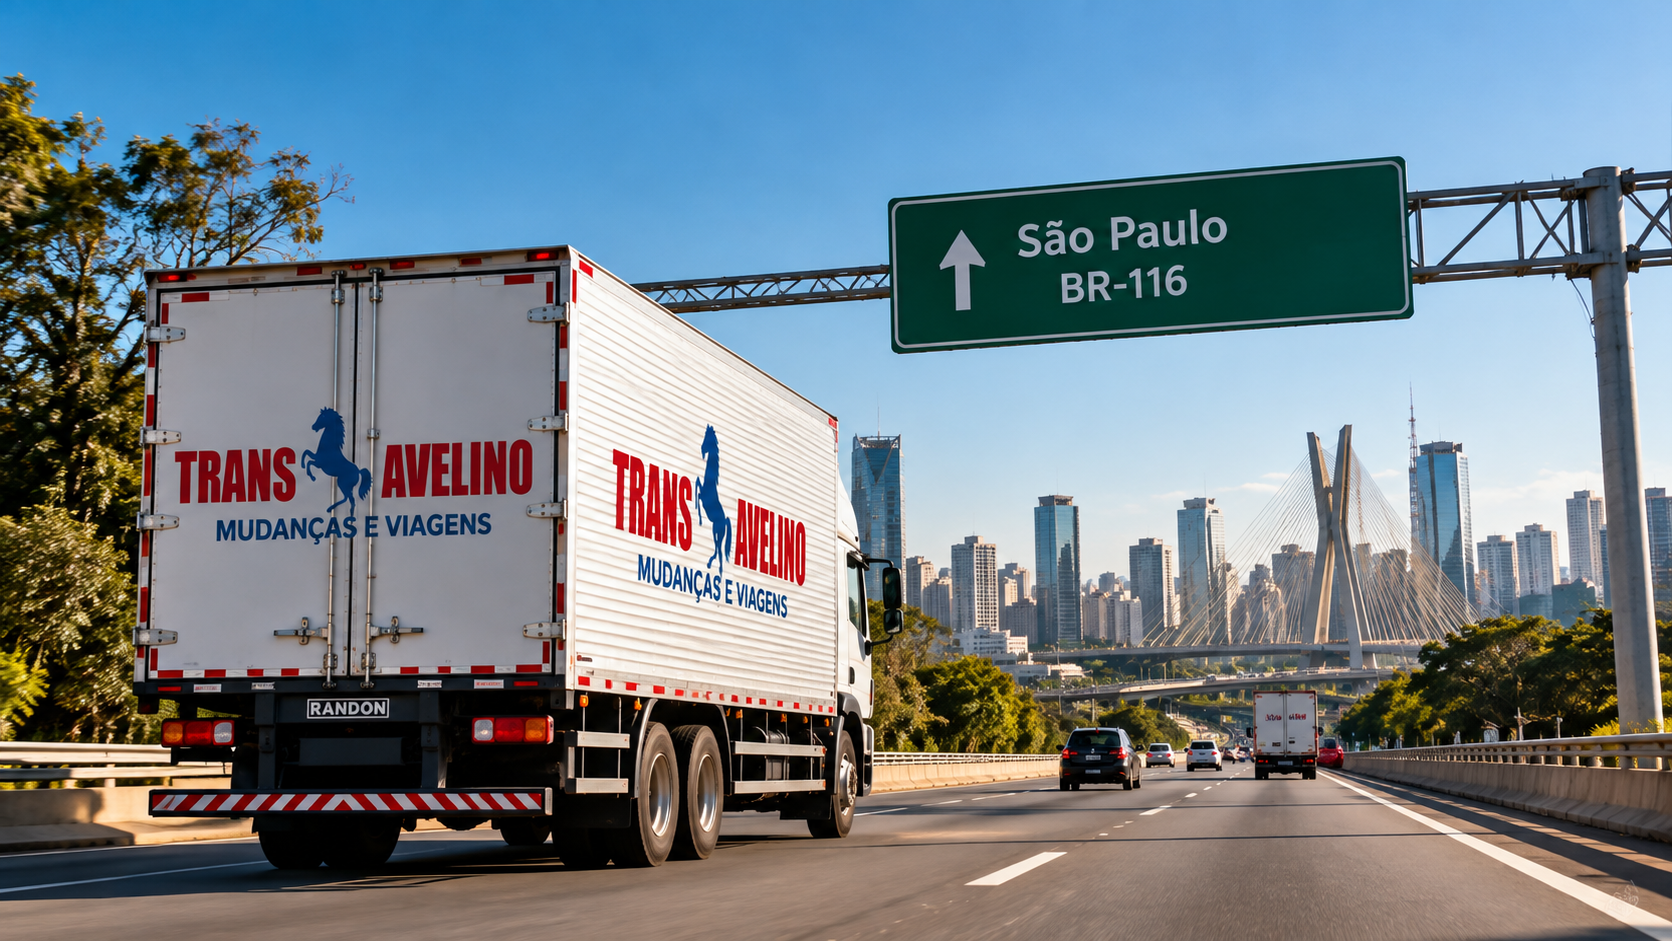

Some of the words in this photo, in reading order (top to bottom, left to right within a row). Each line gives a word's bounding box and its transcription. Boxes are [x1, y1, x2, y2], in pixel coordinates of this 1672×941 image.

[1018, 220, 1093, 258] São
[1111, 209, 1227, 250] Paulo
[1061, 265, 1187, 303] BR-116
[175, 447, 295, 503] TRANS
[382, 440, 532, 498] AVELINO
[217, 516, 356, 544] MUDANÇAS
[365, 516, 378, 537] E
[385, 513, 491, 537] VIAGENS
[613, 449, 692, 551] TRANS
[734, 499, 806, 586] AVELINO
[638, 554, 721, 602] MUDANÇAS
[725, 579, 733, 604] E
[736, 583, 787, 618] VIAGENS
[310, 700, 386, 716] RANDON
